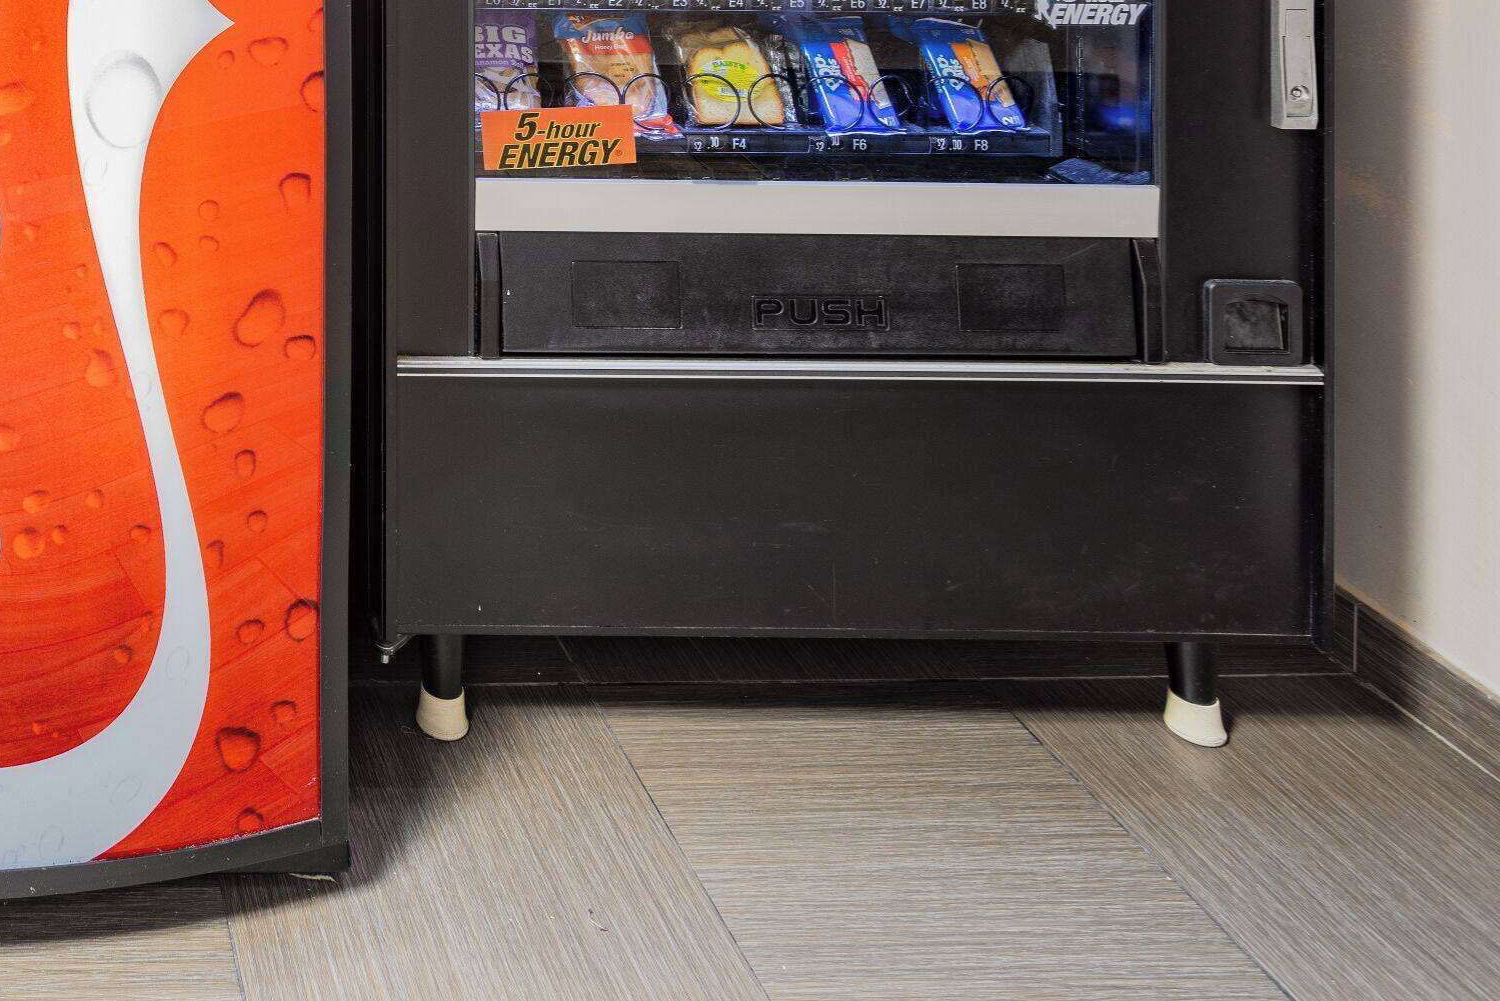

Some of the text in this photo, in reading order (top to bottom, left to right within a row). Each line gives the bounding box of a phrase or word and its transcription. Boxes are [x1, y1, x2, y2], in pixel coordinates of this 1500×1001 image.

[1051, 3, 1148, 26] ENERGY
[581, 26, 635, 44] Jumbo
[594, 44, 613, 52] Honey
[514, 112, 602, 142] 5-hour
[732, 138, 747, 150] F4
[852, 139, 867, 151] F6
[974, 140, 989, 151] F8
[498, 138, 621, 170] ENERGY
[756, 299, 887, 326] PUSH
